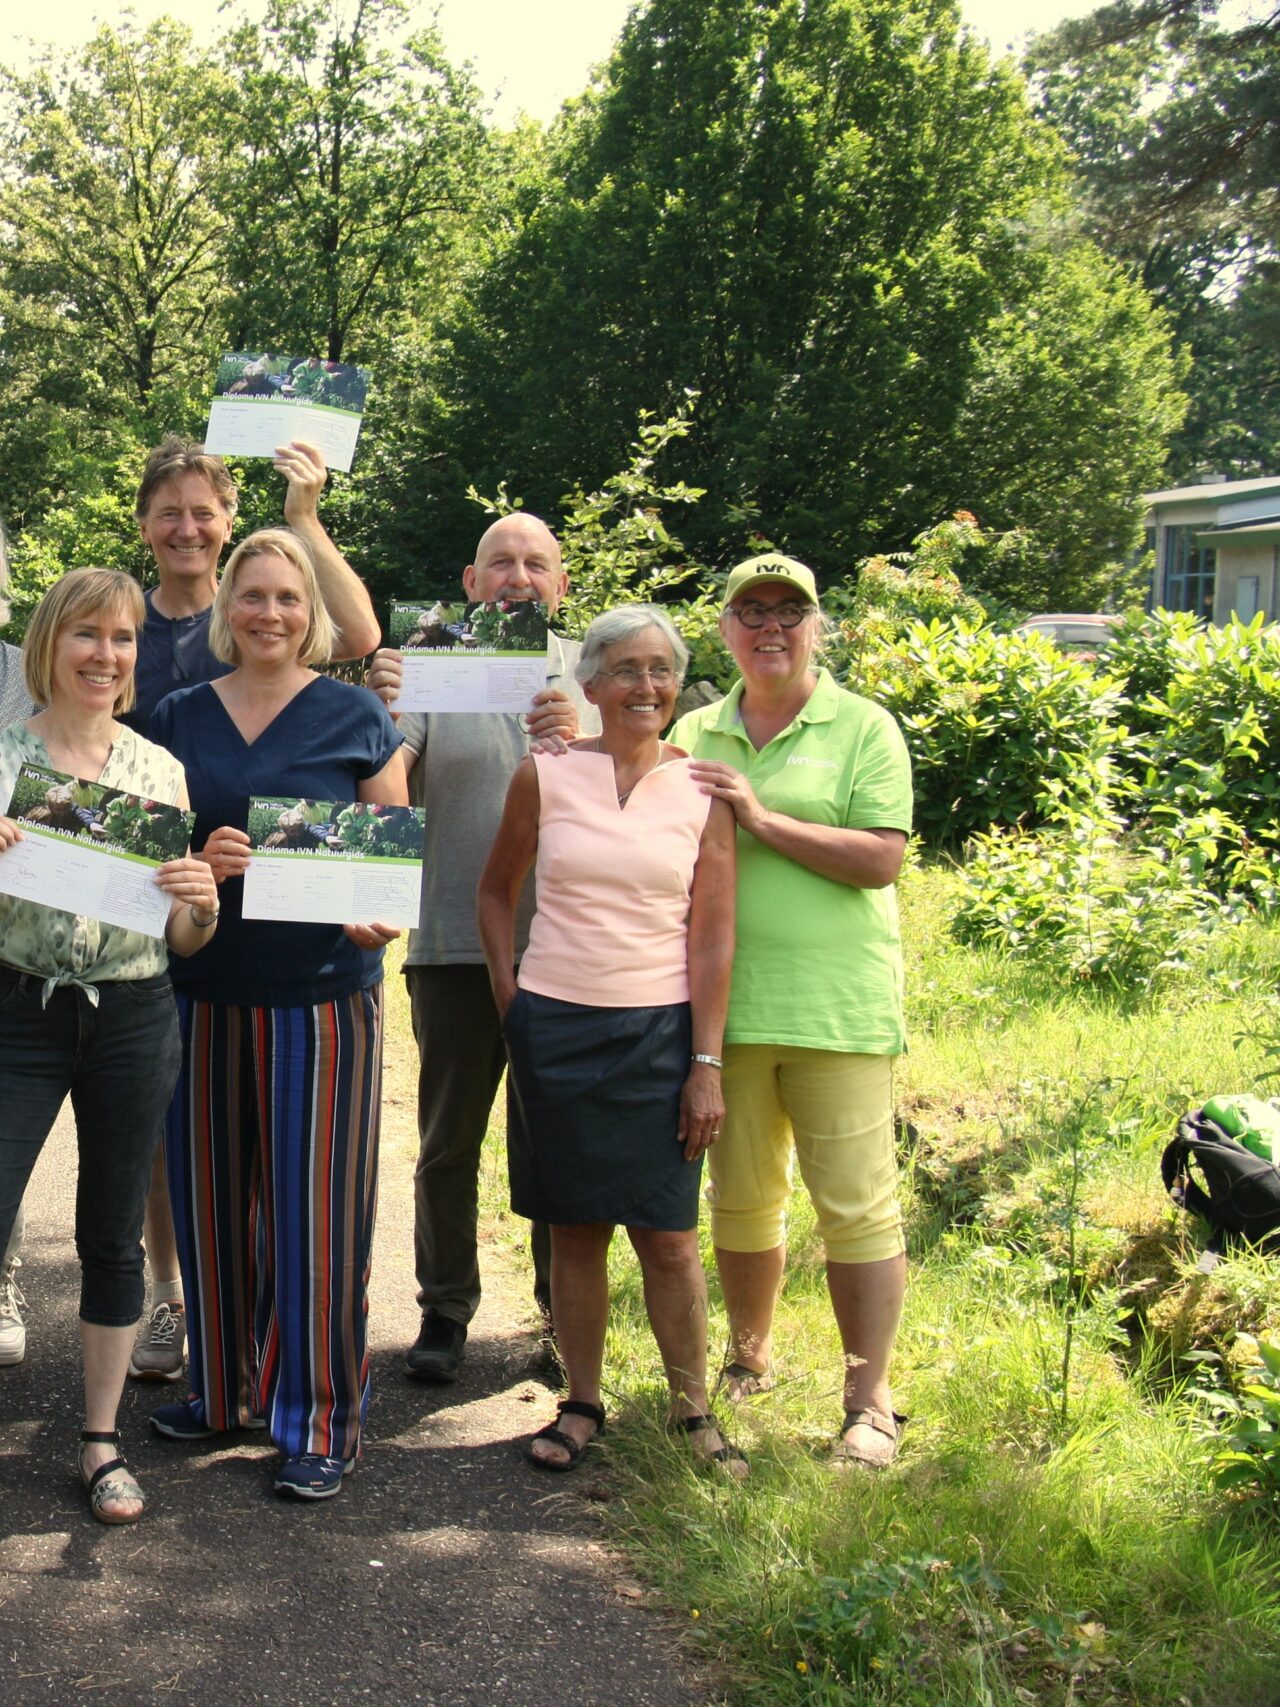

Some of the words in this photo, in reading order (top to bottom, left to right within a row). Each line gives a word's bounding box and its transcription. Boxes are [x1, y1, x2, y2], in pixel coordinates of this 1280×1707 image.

[222, 392, 254, 401] Diploma
[270, 396, 313, 406] Natuurgids
[400, 645, 434, 654] Diploma
[436, 646, 450, 654] IVN
[452, 645, 497, 656] Natuurgids
[16, 816, 56, 834] Diploma
[58, 827, 74, 839] IVN
[76, 833, 126, 854] Natuurgids
[258, 846, 294, 856] Diploma
[297, 848, 313, 856] IVN
[315, 849, 364, 860] Natuurgids
